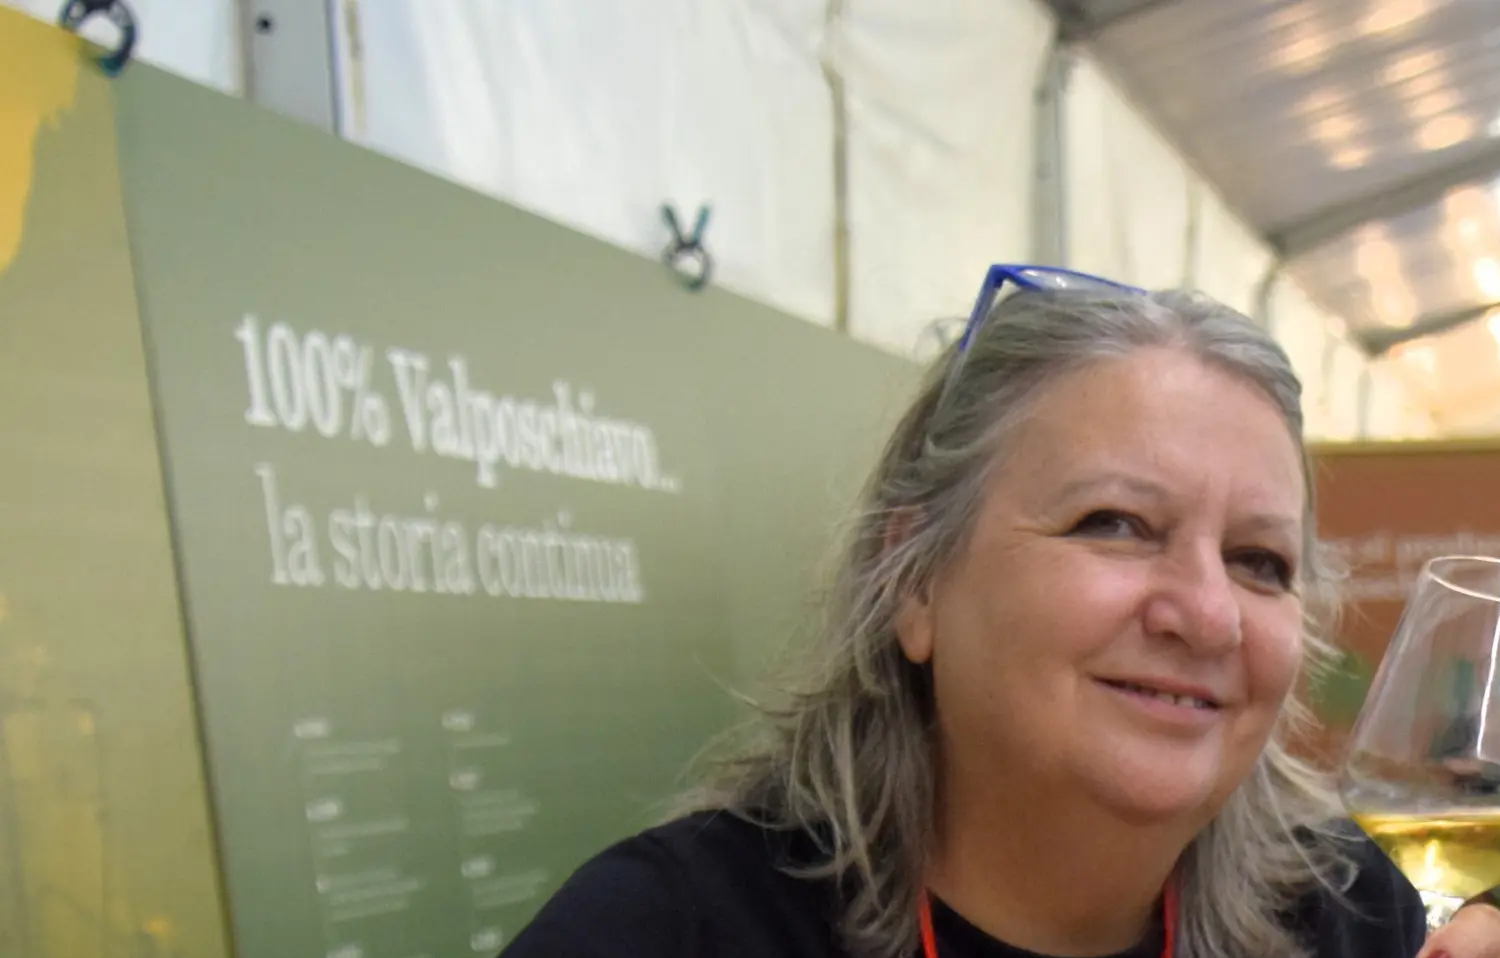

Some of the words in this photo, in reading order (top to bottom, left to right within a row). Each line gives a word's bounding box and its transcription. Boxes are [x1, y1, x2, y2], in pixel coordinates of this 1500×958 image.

[234, 313, 391, 446] 100%
[254, 463, 323, 586] la
[327, 492, 477, 594] storia
[478, 505, 646, 603] continua
